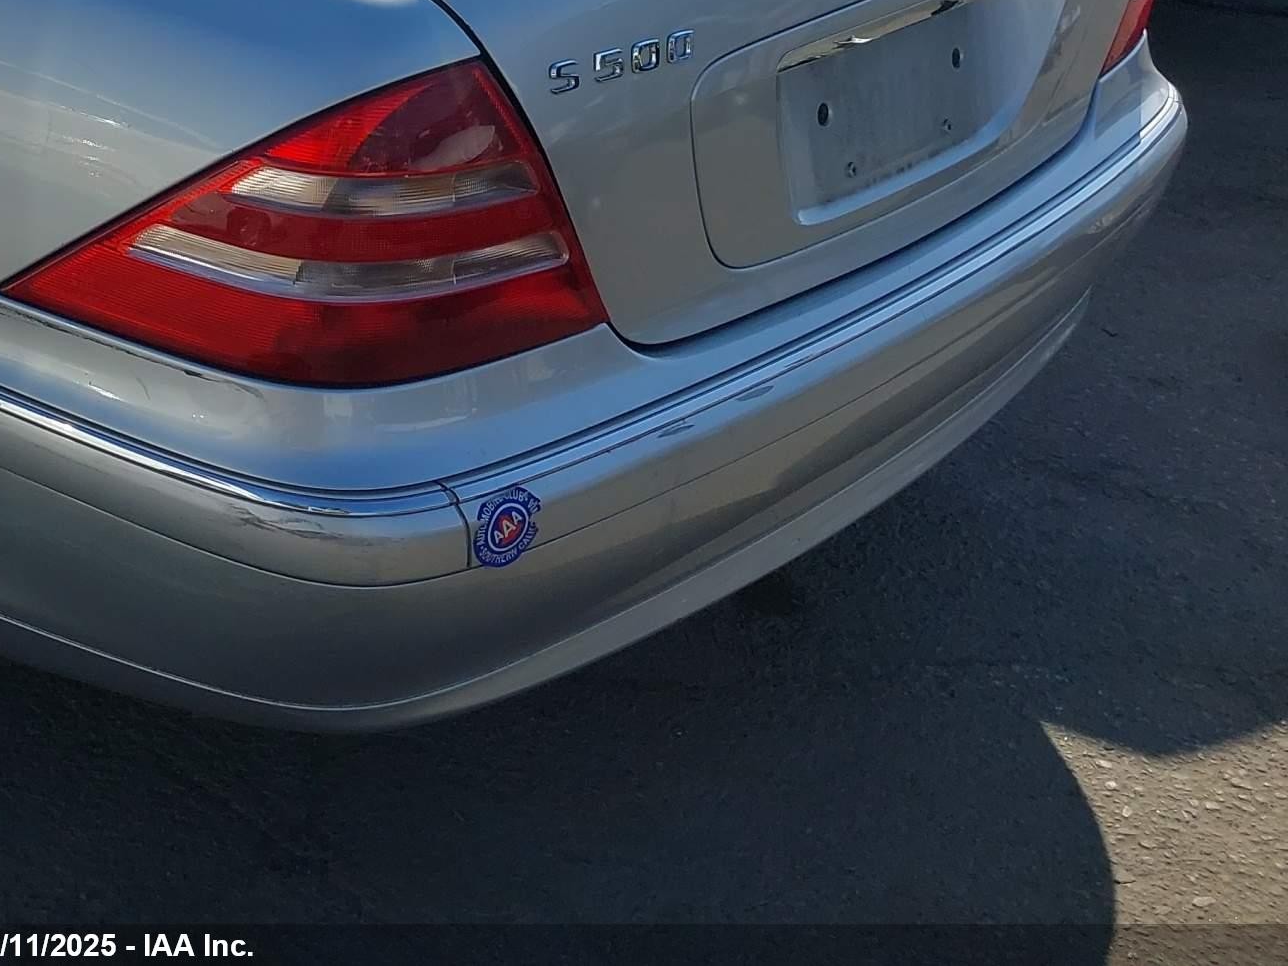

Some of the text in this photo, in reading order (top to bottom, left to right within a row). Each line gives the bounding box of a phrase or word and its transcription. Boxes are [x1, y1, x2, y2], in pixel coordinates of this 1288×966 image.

[548, 29, 696, 95] S 500
[493, 510, 523, 544] AAA
